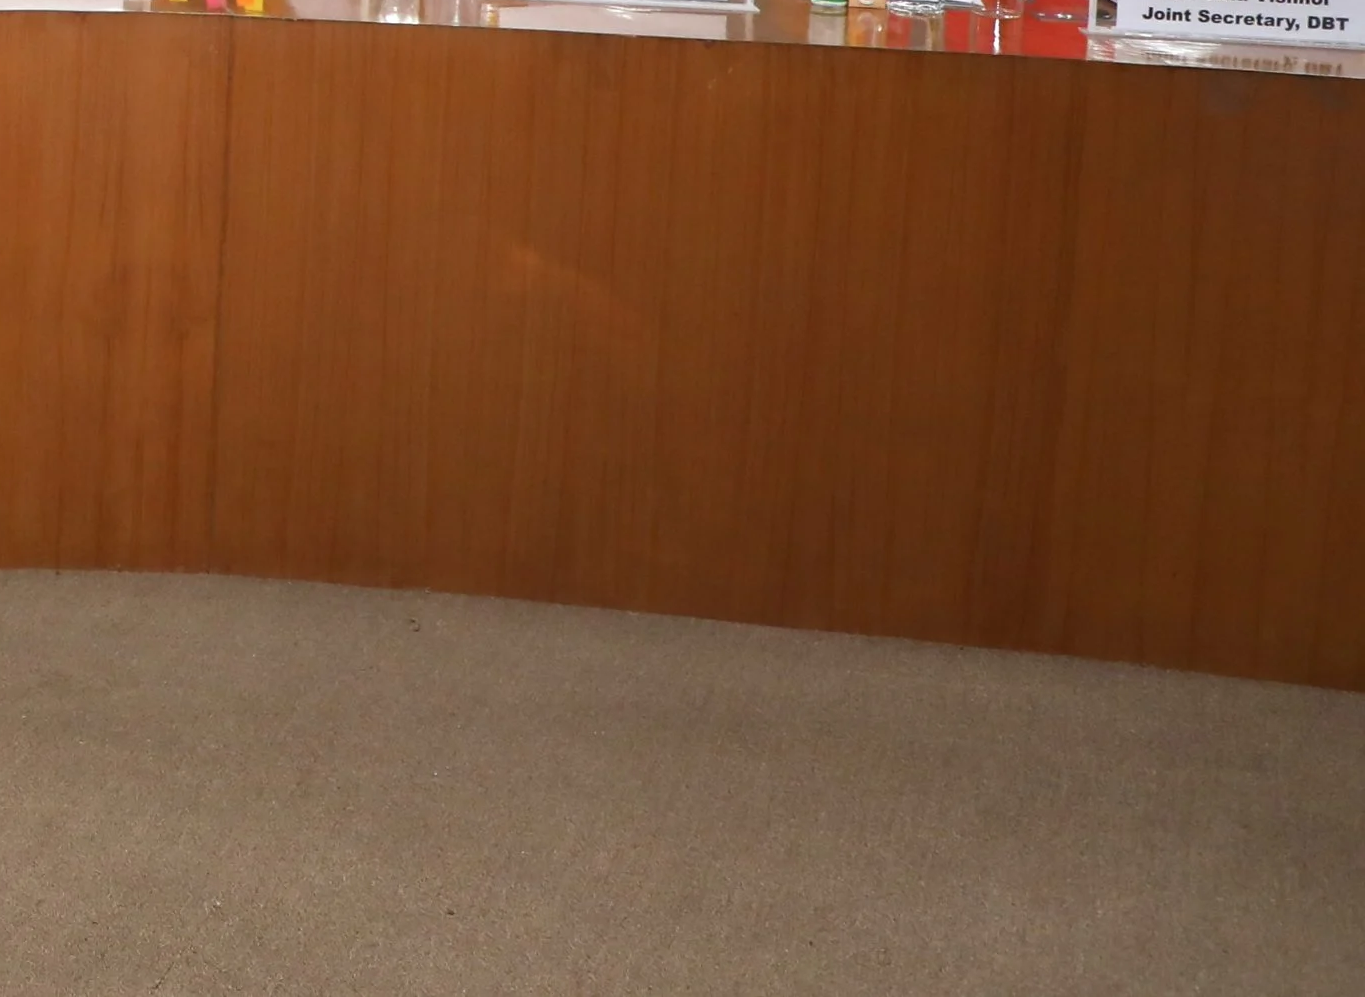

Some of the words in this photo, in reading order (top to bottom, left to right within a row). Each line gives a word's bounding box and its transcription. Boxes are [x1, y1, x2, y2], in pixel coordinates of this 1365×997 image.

[1142, 7, 1191, 22] Joint
[1198, 9, 1300, 32] Secretary,
[1308, 16, 1349, 31] DBT
